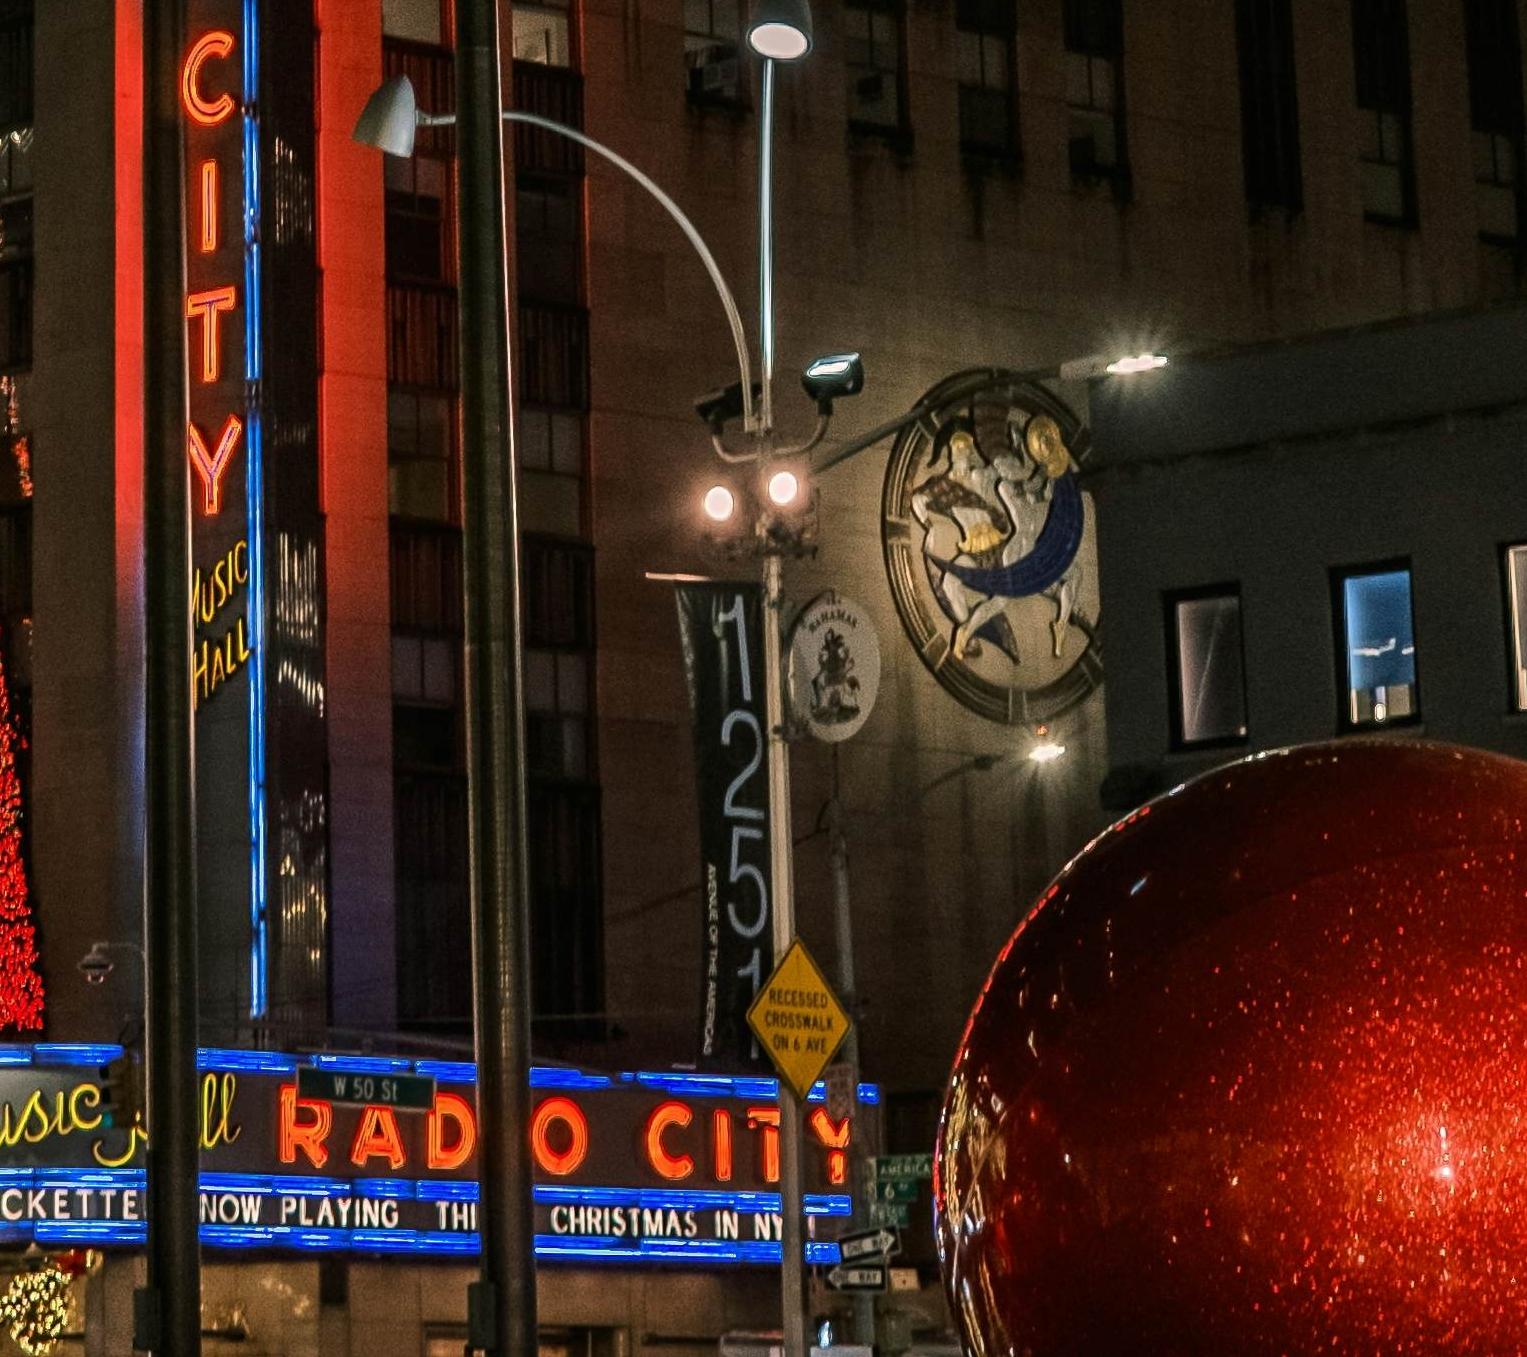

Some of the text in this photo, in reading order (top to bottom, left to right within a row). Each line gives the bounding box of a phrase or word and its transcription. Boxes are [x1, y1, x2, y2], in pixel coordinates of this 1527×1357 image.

[182, 30, 243, 517] CITY
[768, 988, 828, 1009] RECESSED
[764, 1009, 834, 1033] CROSSWALK
[772, 1034, 828, 1054] ON 6 AVE
[334, 1076, 397, 1100] W 50 St
[276, 1083, 589, 1176] RADO
[645, 1099, 851, 1185] CITY
[199, 1193, 262, 1224] NOW
[280, 1196, 399, 1229] PLAYING
[550, 1204, 697, 1237] CHRISTMAS
[714, 1210, 739, 1240] IN
